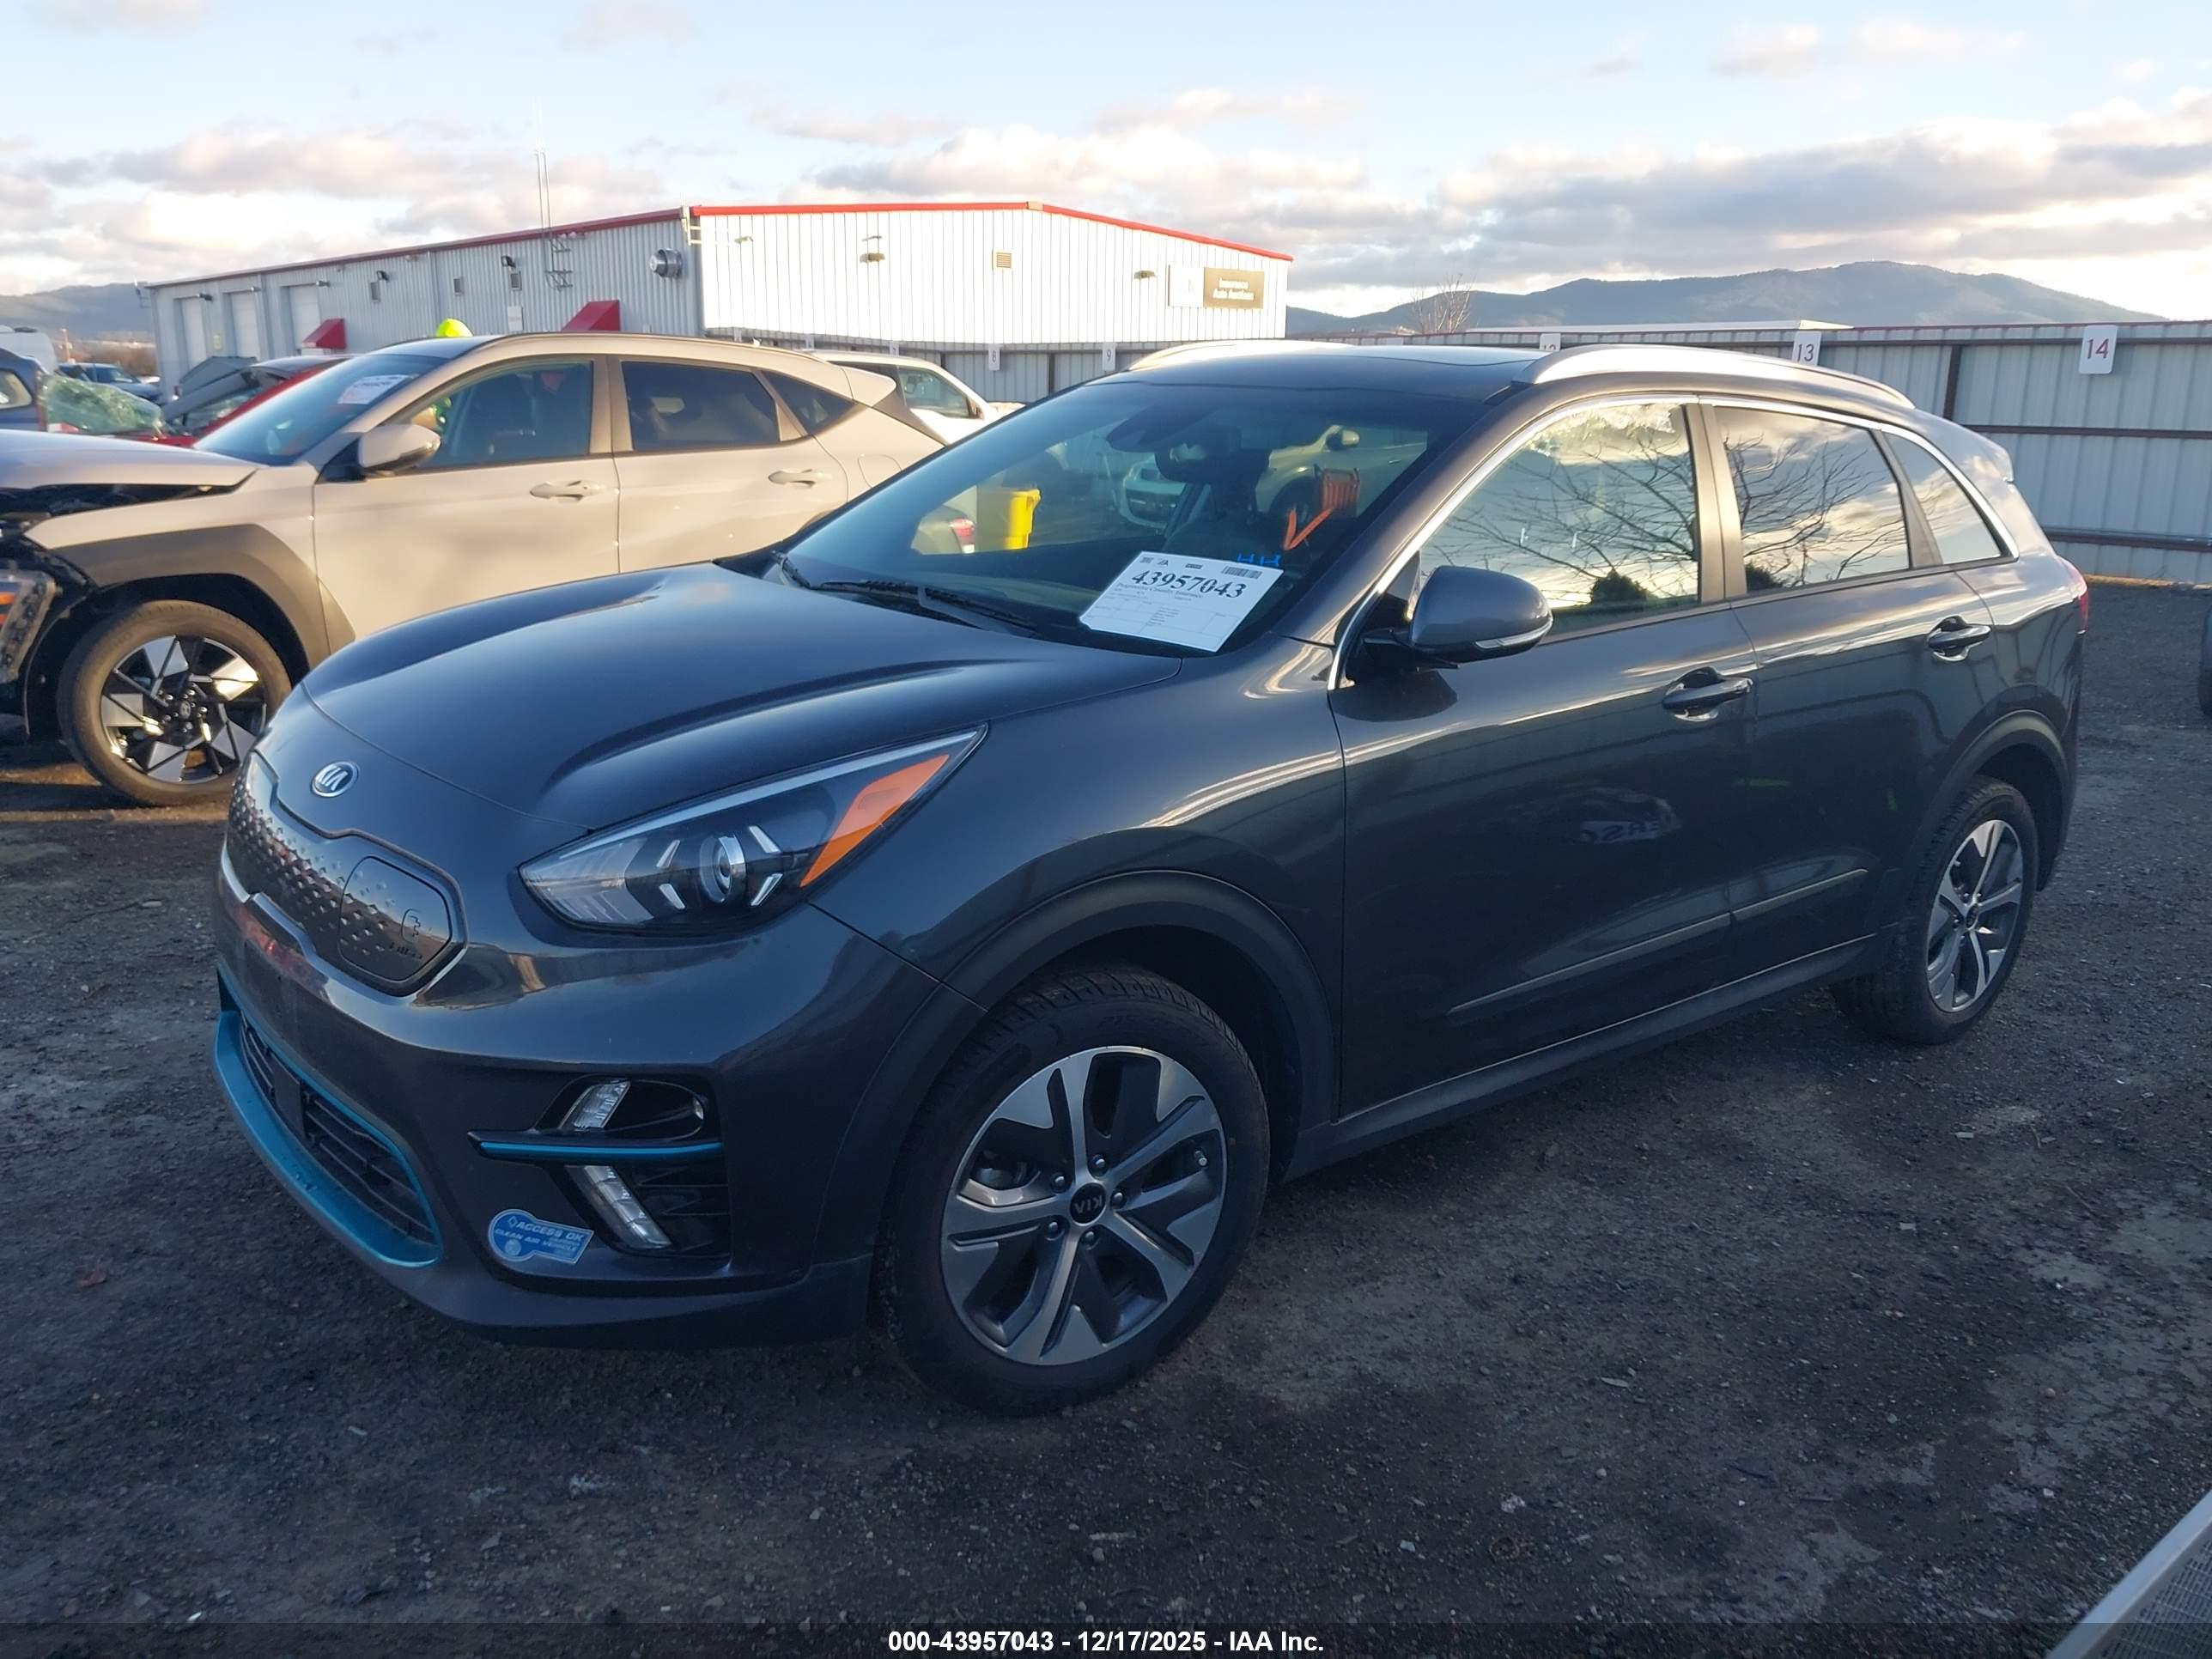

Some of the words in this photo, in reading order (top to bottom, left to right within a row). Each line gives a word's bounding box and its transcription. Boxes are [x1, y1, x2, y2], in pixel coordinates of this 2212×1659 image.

[992, 350, 997, 362] 8
[1106, 349, 1112, 362] 9
[1797, 343, 1814, 362] 13
[2087, 338, 2109, 359] 14
[1132, 570, 1247, 599] 43957043
[317, 765, 348, 791] KIA
[1073, 1194, 1103, 1214] KIA
[494, 1229, 524, 1240] CLEAN
[516, 1221, 563, 1237] ACCESS
[565, 1232, 585, 1242] OK
